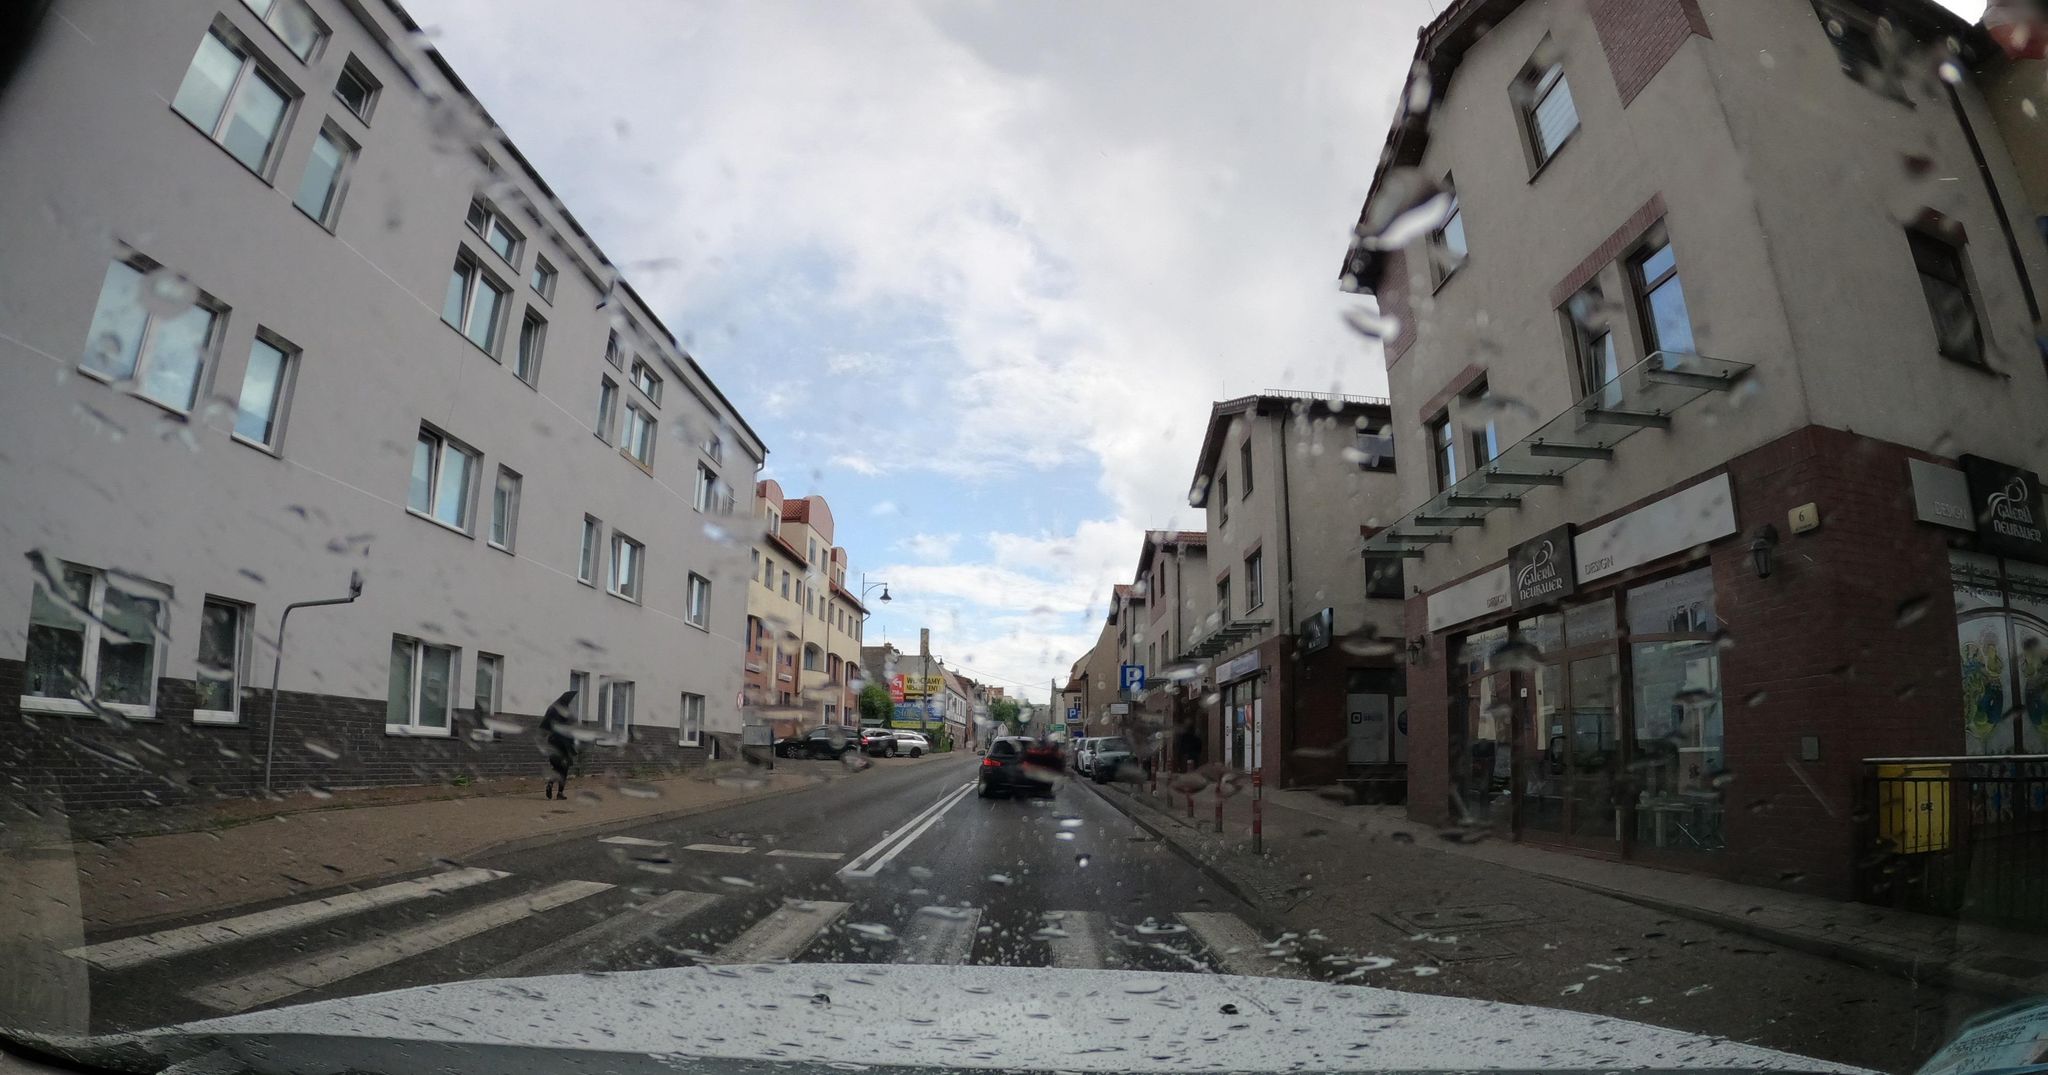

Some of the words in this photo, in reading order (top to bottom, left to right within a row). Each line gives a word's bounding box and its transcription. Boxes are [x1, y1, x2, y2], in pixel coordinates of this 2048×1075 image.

[1799, 511, 1805, 522] 6
[1934, 501, 1968, 520] DESIGN
[1584, 555, 1614, 576] DESIGN
[1486, 591, 1507, 609] DESIGN
[1126, 667, 1143, 687] P
[1069, 708, 1077, 718] P
